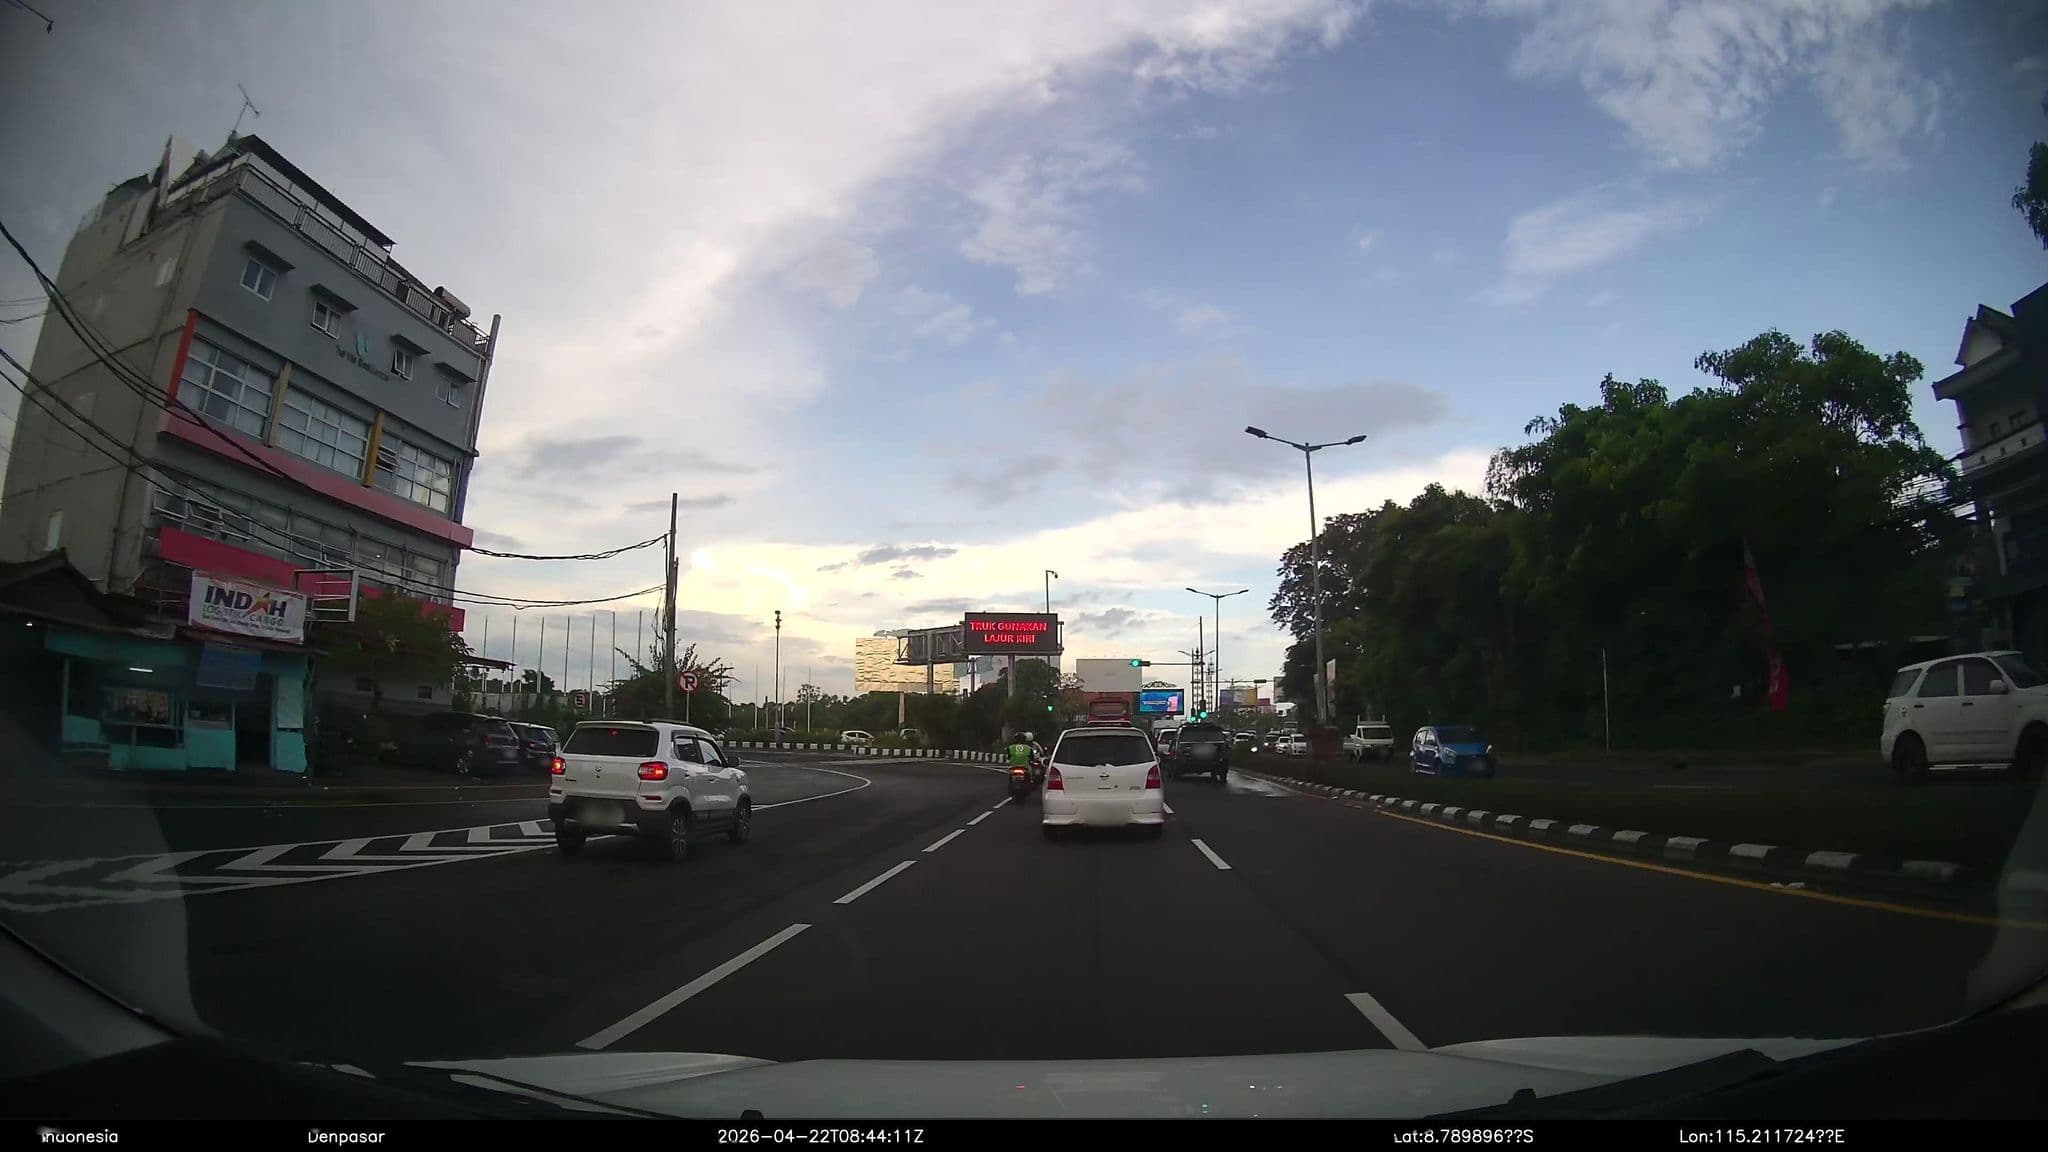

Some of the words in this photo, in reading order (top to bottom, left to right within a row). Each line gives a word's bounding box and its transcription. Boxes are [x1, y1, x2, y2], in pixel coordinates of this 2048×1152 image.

[204, 585, 288, 618] INDAH
[250, 614, 285, 627] CARGO
[970, 621, 995, 632] TRUK
[997, 621, 1048, 632] GUNAKAN
[984, 634, 1014, 643] LAJUR
[1016, 634, 1035, 643] KIRI
